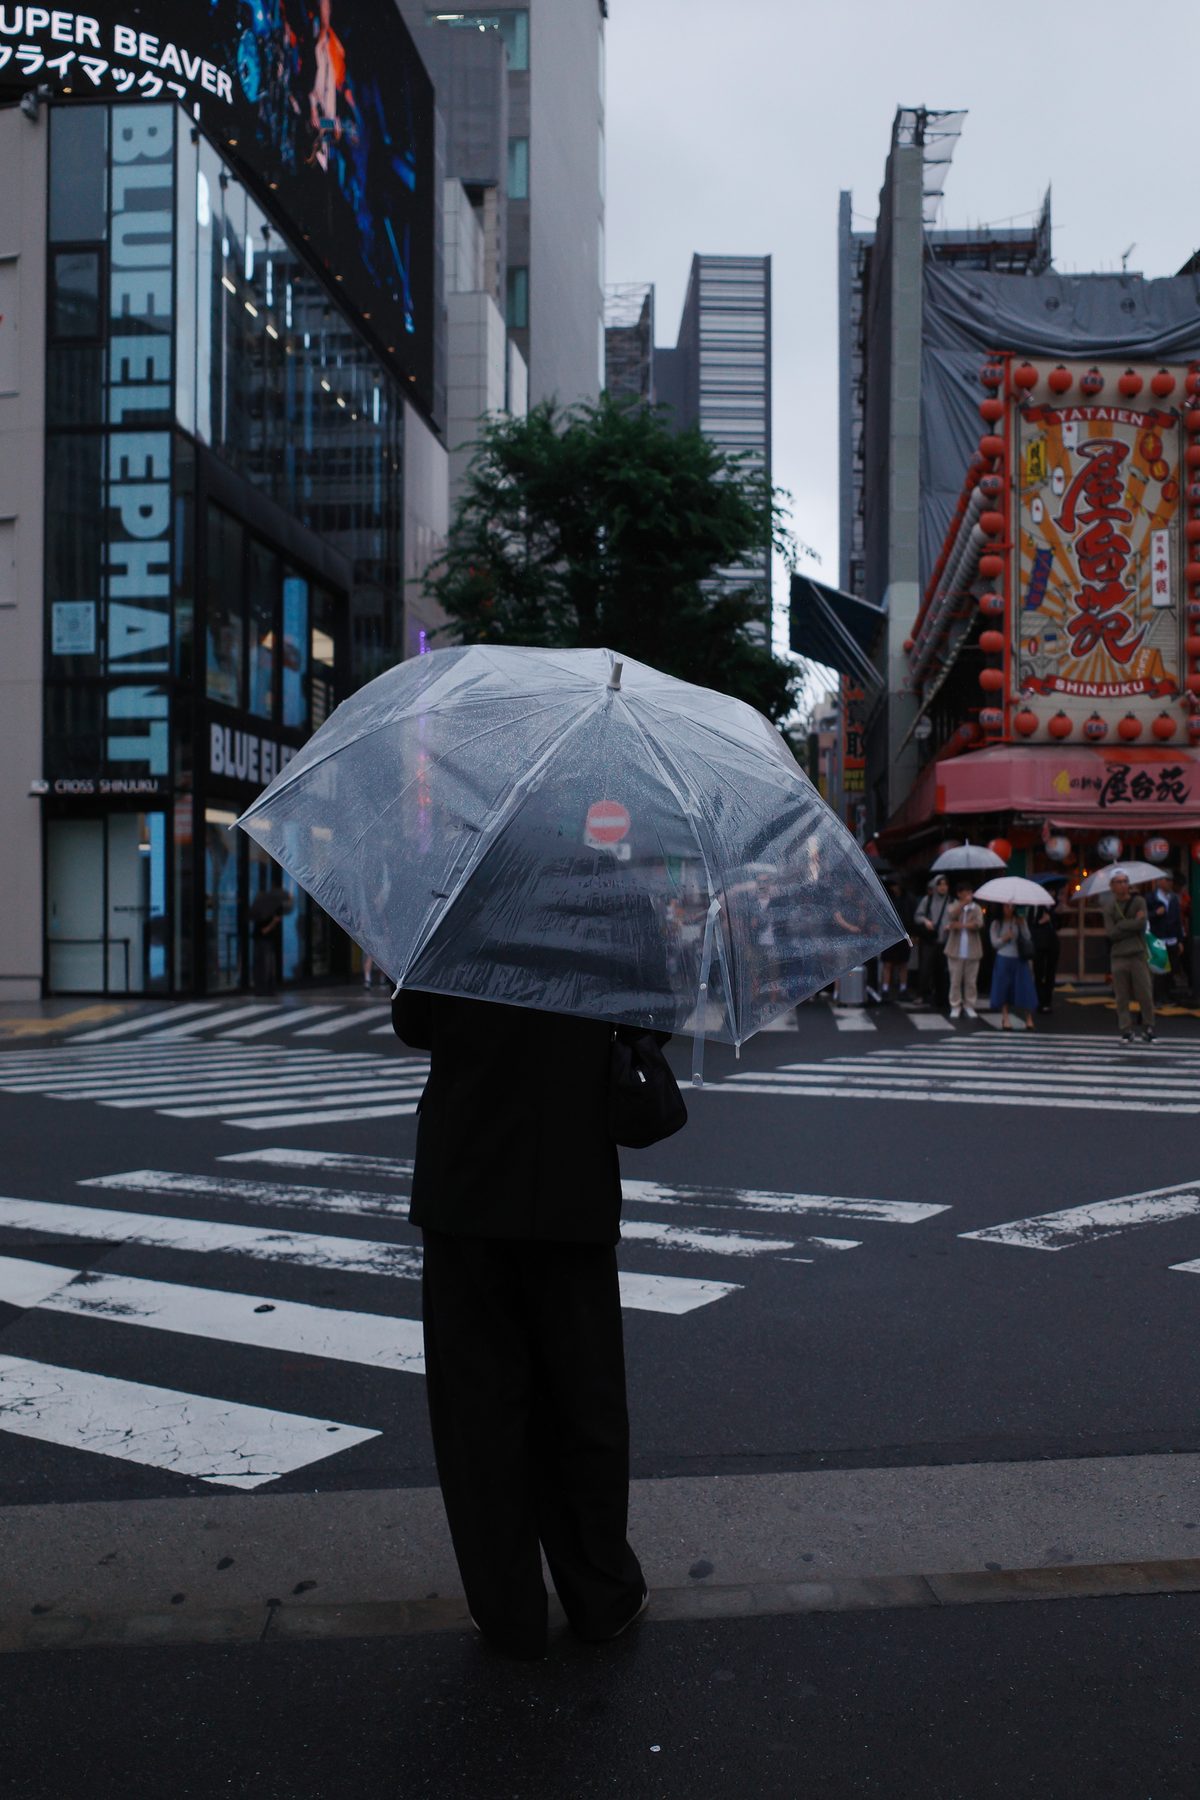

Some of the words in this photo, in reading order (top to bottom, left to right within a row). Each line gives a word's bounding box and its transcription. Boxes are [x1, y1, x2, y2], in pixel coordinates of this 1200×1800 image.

[0, 4, 101, 49] UPER
[114, 24, 234, 105] BEAVER
[110, 103, 174, 318] BLUE
[1056, 407, 1145, 426] YATAIEN
[107, 335, 171, 775] ELEPHANT
[1054, 678, 1145, 697] SHINJUKU
[210, 722, 259, 784] BLUE
[54, 779, 95, 794] CROSS
[99, 778, 158, 794] SHINJUKU
